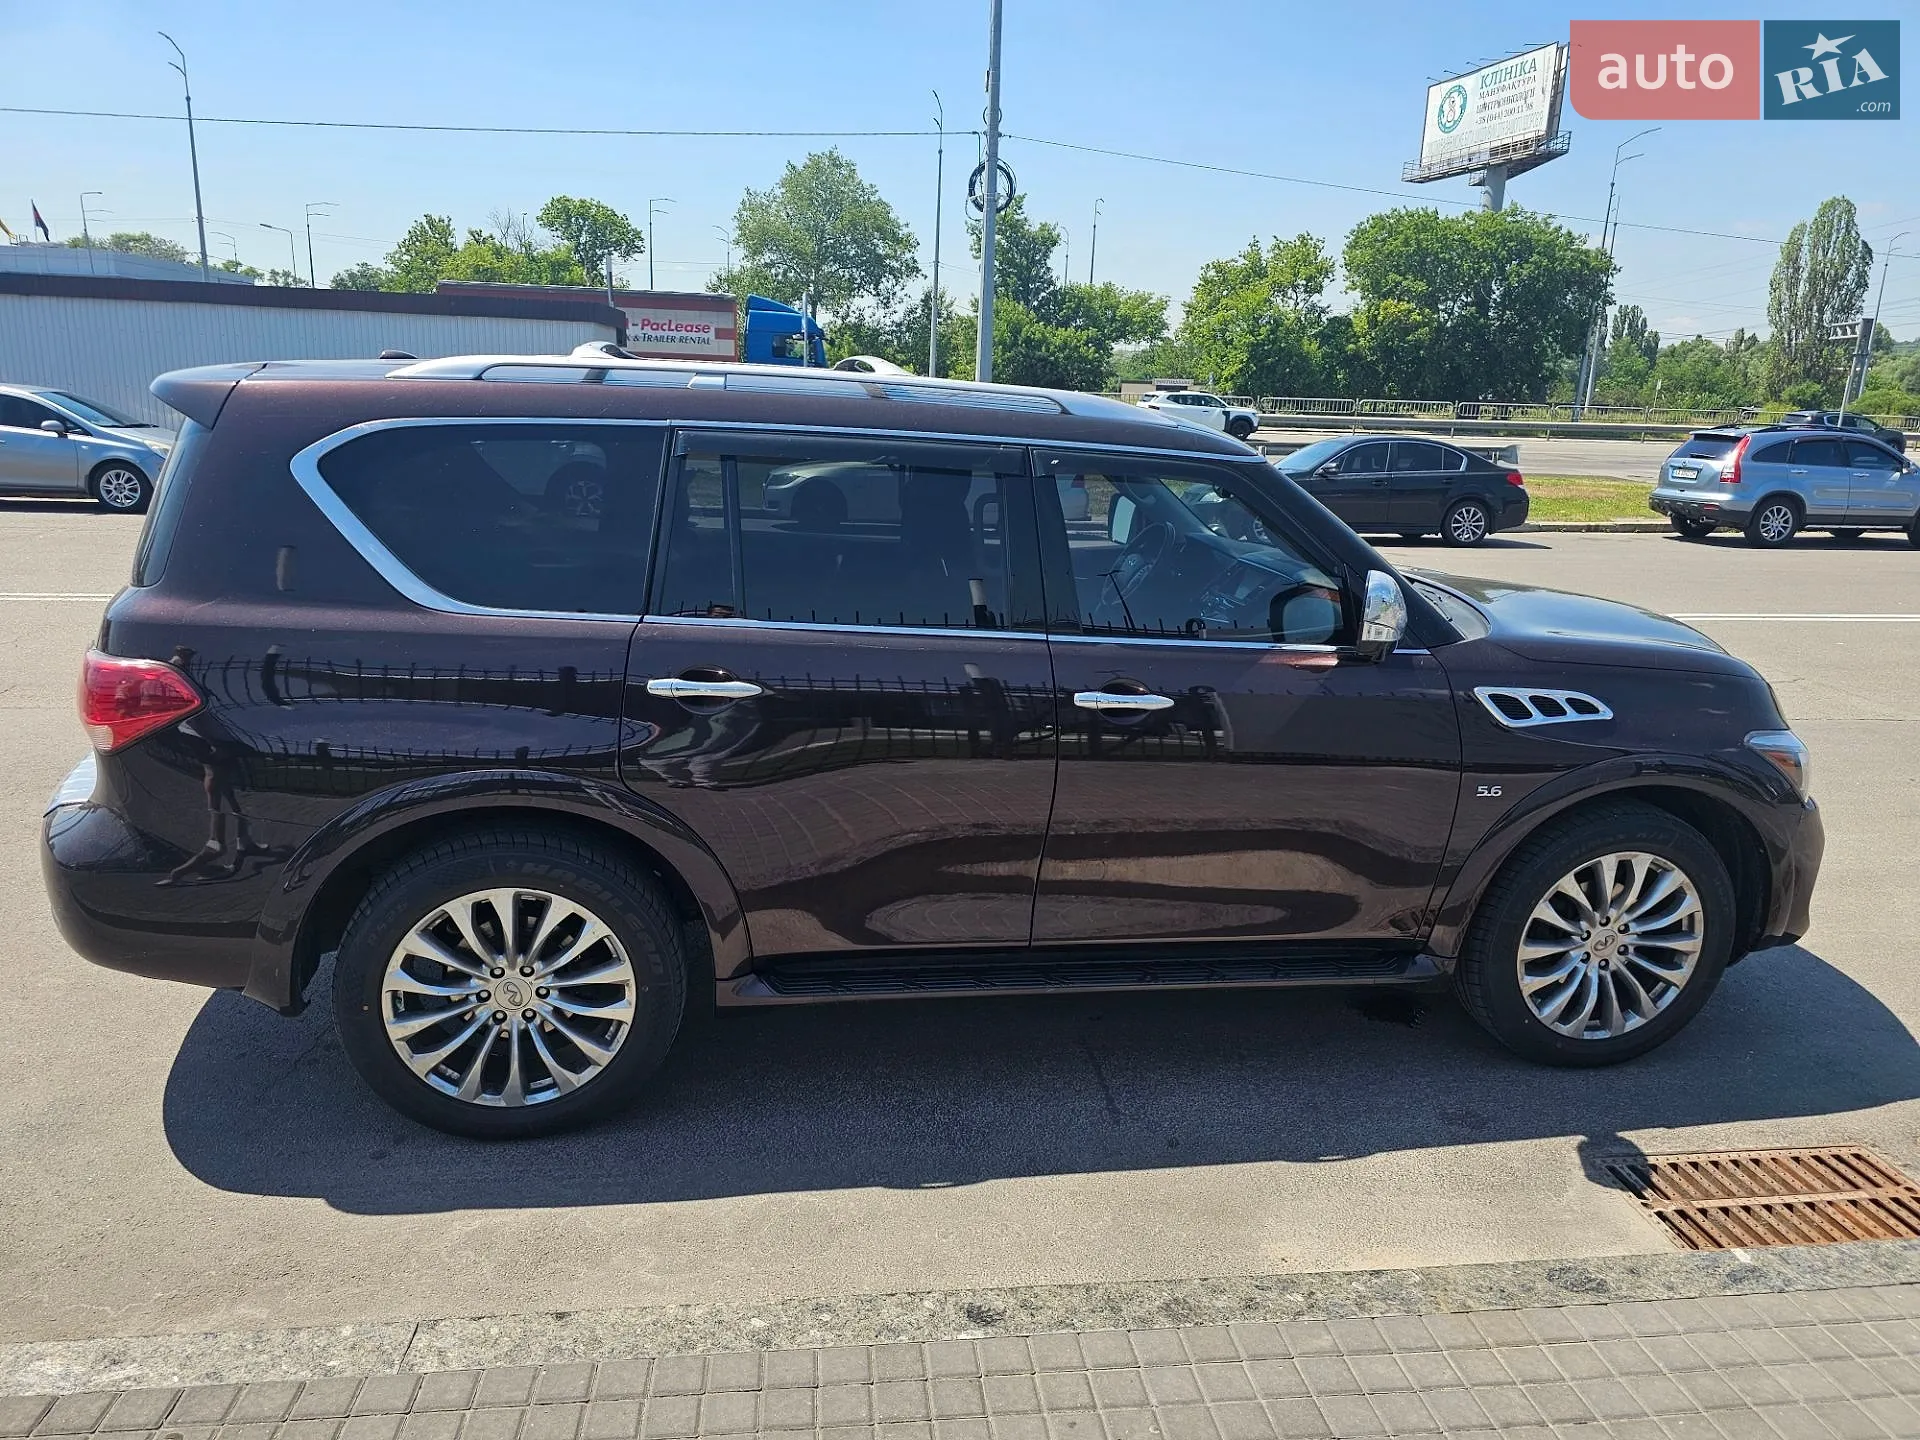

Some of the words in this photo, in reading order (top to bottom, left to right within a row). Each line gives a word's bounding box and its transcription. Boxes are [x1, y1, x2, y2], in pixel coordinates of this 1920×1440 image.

[1480, 57, 1537, 90] КЛІНІКА
[640, 333, 677, 344] TRAILER
[678, 335, 711, 346] RENTAL
